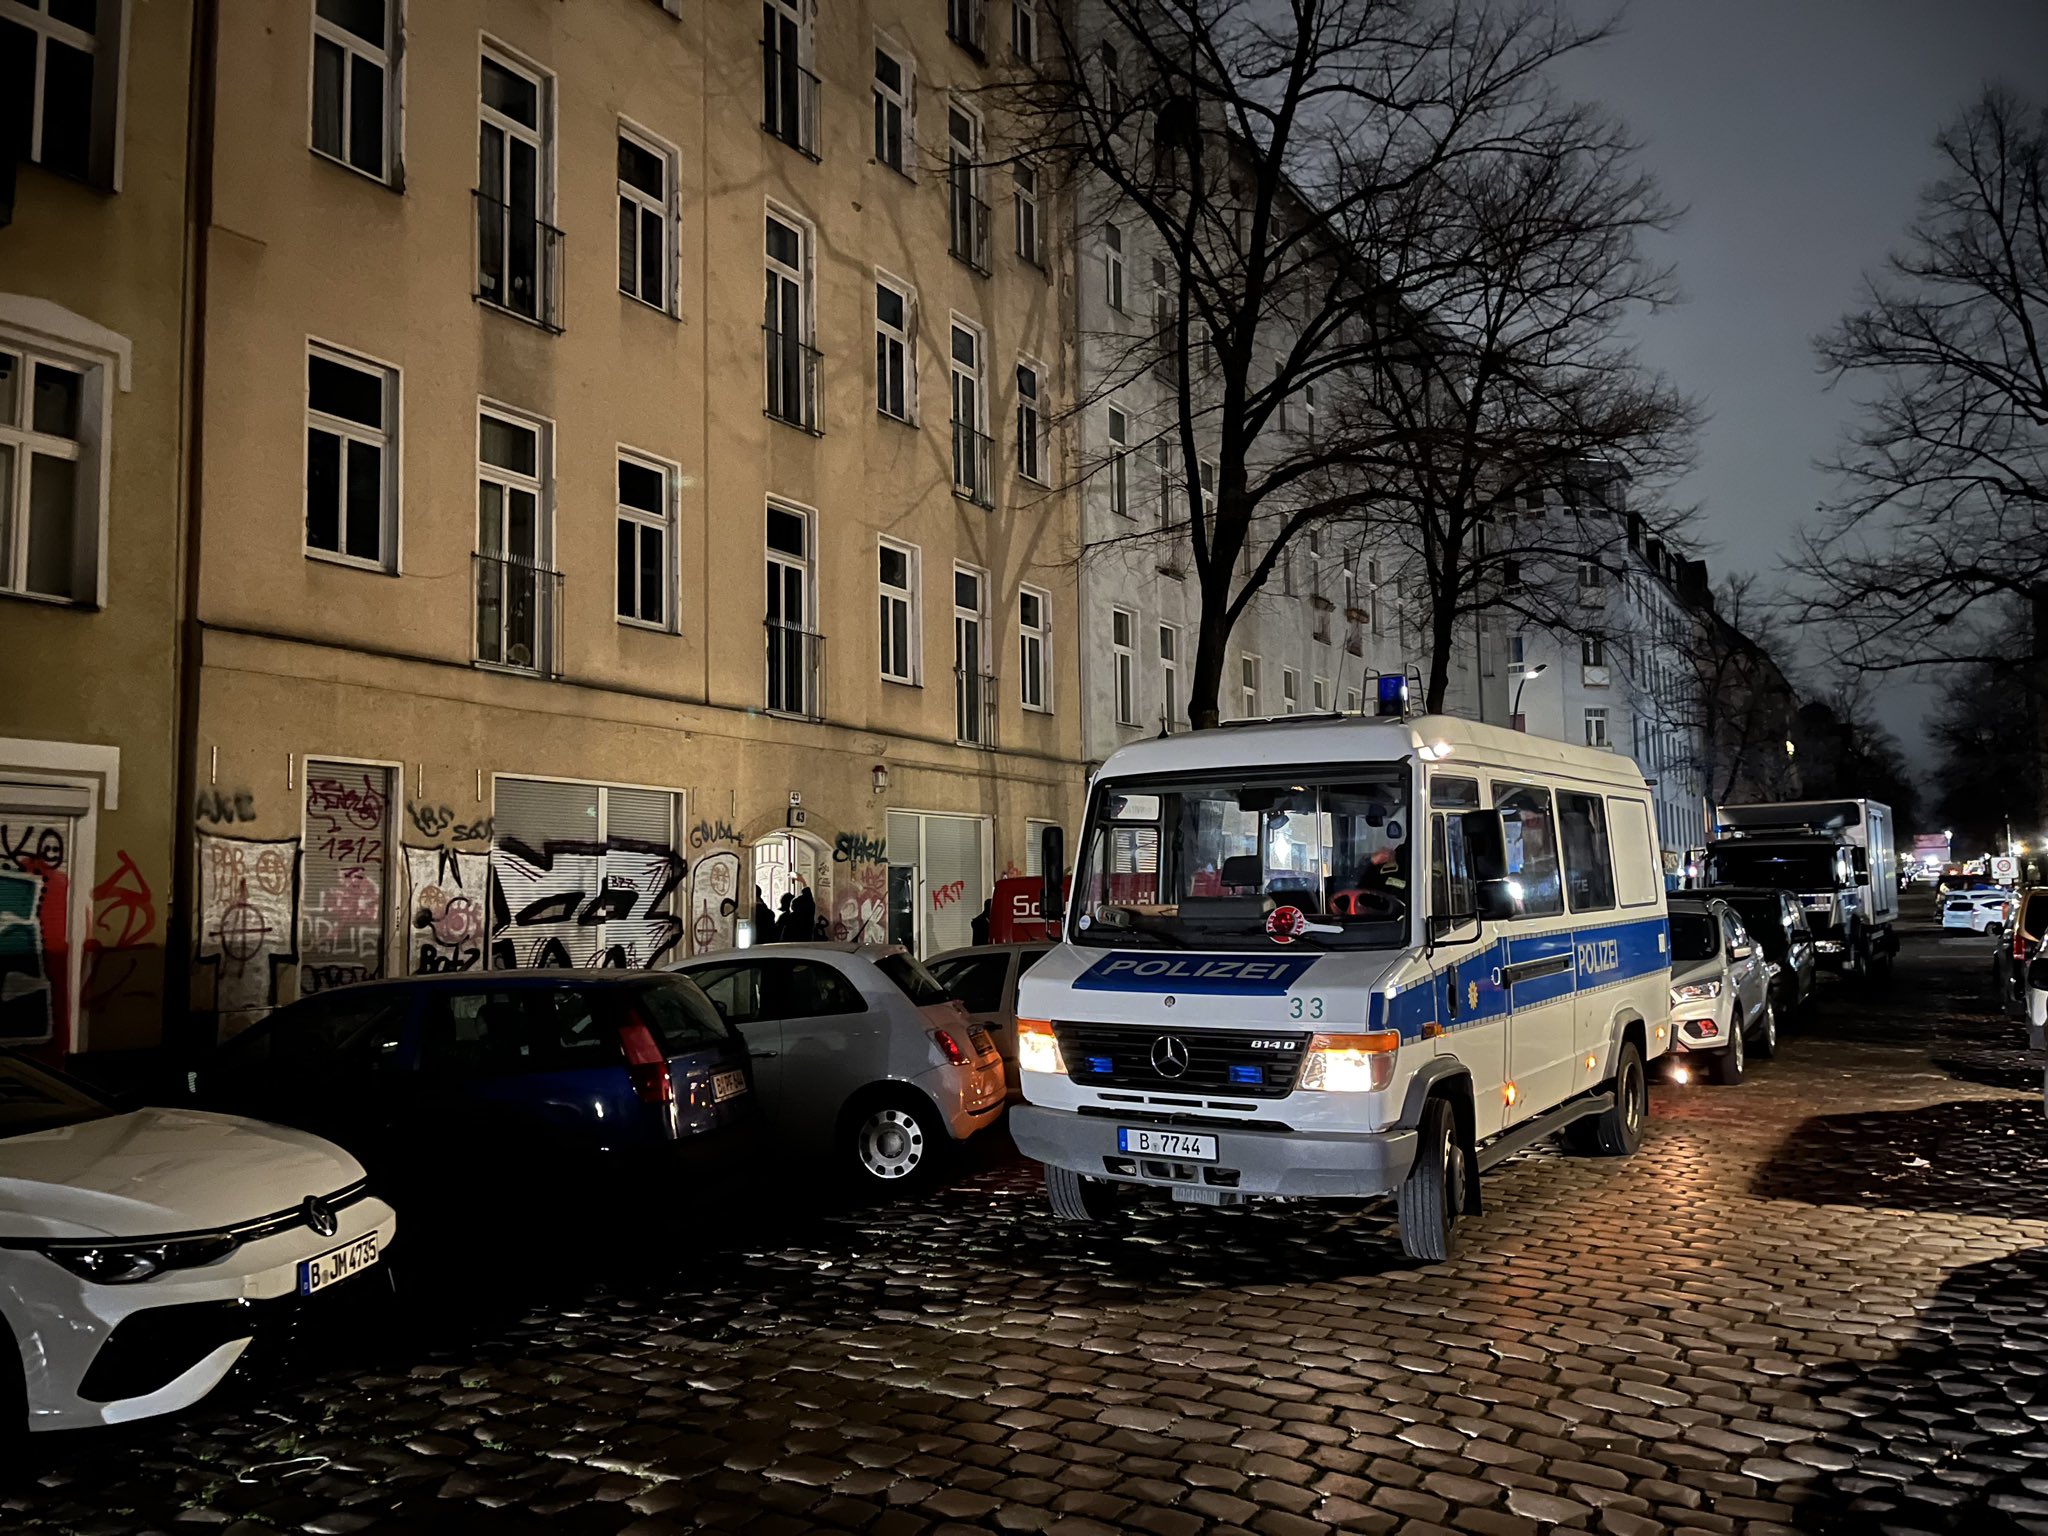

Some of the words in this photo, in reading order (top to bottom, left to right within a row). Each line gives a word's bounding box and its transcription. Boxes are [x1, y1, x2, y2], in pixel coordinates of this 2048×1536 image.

[796, 812, 805, 823] 43
[319, 837, 382, 864] 1312
[1577, 939, 1619, 977] POLIZEI
[1101, 960, 1290, 980] POLIZEI
[1250, 1040, 1281, 1049] 814
[1139, 1133, 1150, 1151] B
[1160, 1135, 1201, 1156] 7744
[311, 1263, 321, 1288] B
